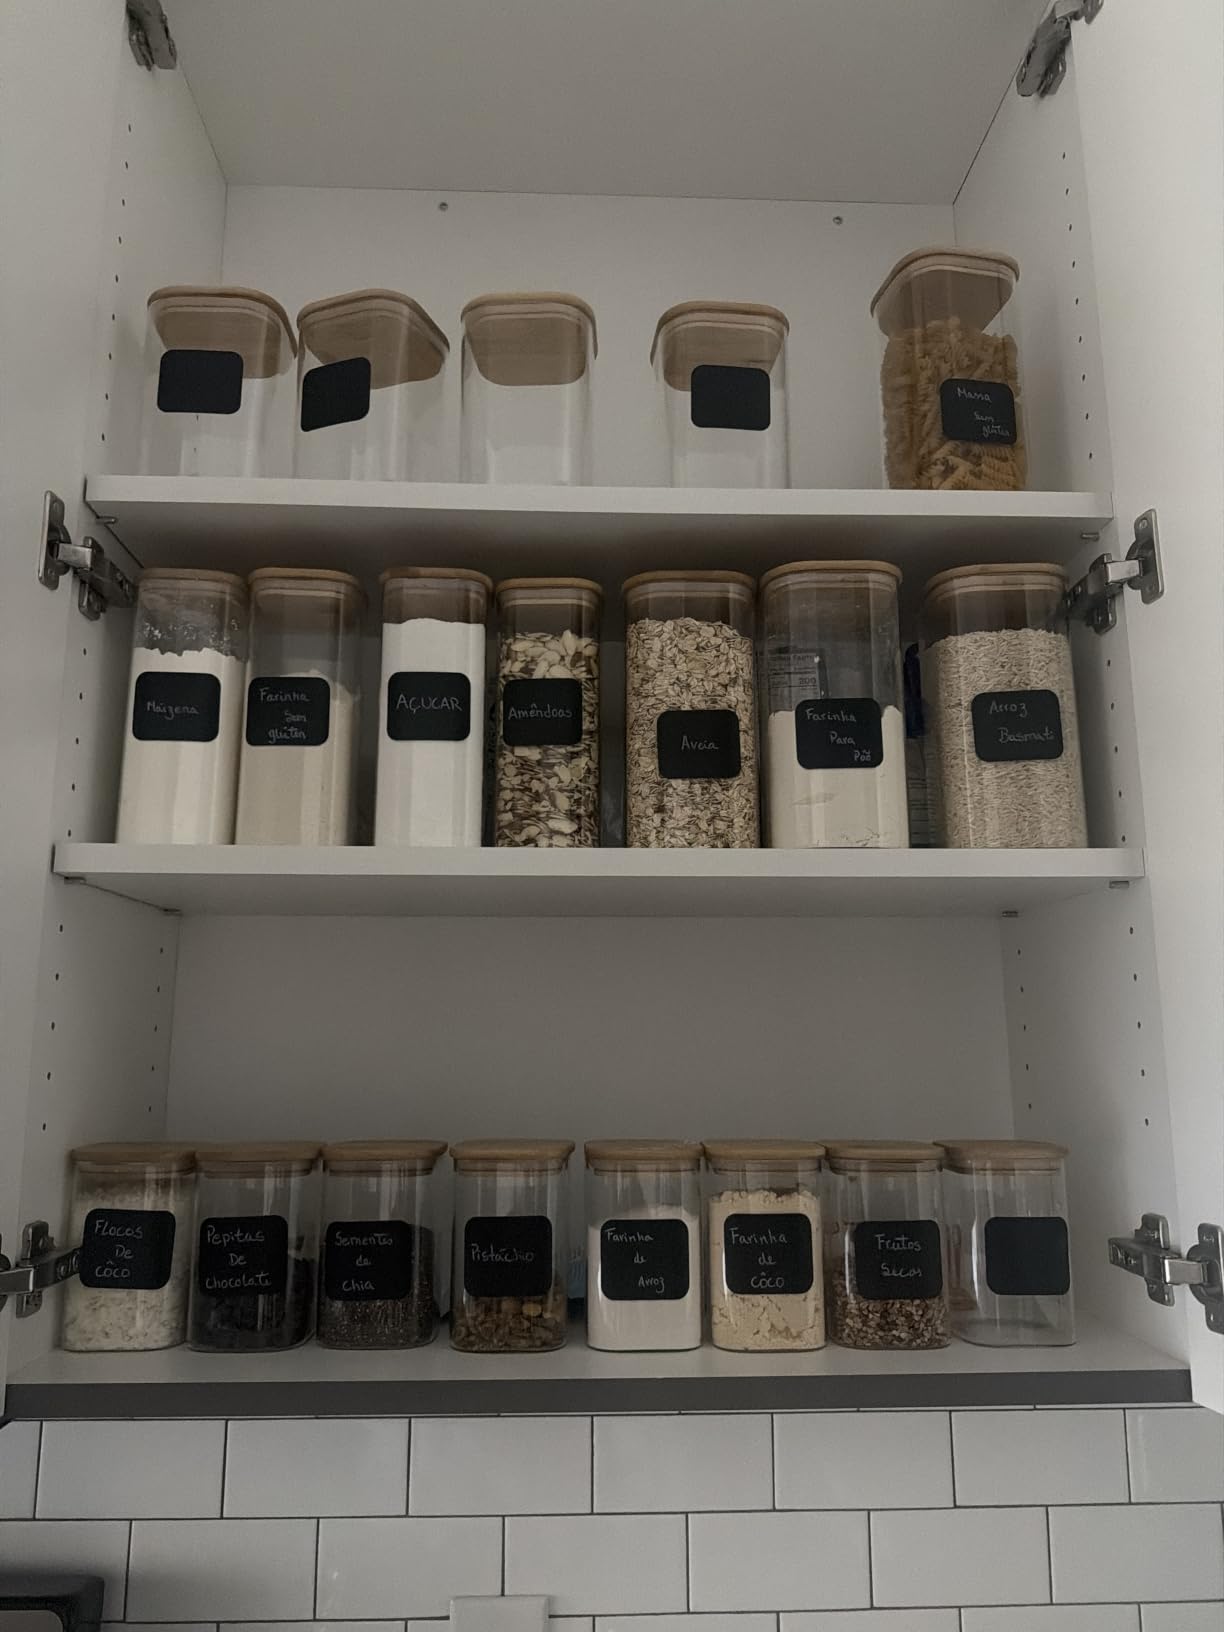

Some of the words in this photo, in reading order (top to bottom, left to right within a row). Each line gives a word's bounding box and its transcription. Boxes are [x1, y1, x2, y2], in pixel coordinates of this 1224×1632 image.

[957, 387, 992, 403] Massa
[258, 687, 310, 702] Farinha
[147, 700, 200, 720] Maizena
[395, 693, 463, 714] AÇUCAR
[508, 703, 573, 720] Amêndoas
[989, 701, 1028, 718] Arroz
[805, 707, 857, 722] Farinha
[680, 735, 720, 751] Aveia
[829, 731, 856, 745] Para
[998, 726, 1056, 744] Basmati
[207, 1224, 265, 1247] Pepitas
[335, 1231, 393, 1247] Sementes
[604, 1226, 655, 1242] Farinha
[729, 1227, 788, 1245] Farinha
[874, 1233, 922, 1251] Frutos
[115, 1244, 134, 1259] De
[229, 1253, 247, 1266] De
[633, 1251, 648, 1264] de
[757, 1254, 777, 1266] de
[880, 1263, 922, 1278] Secos
[637, 1274, 665, 1294] Arroz
